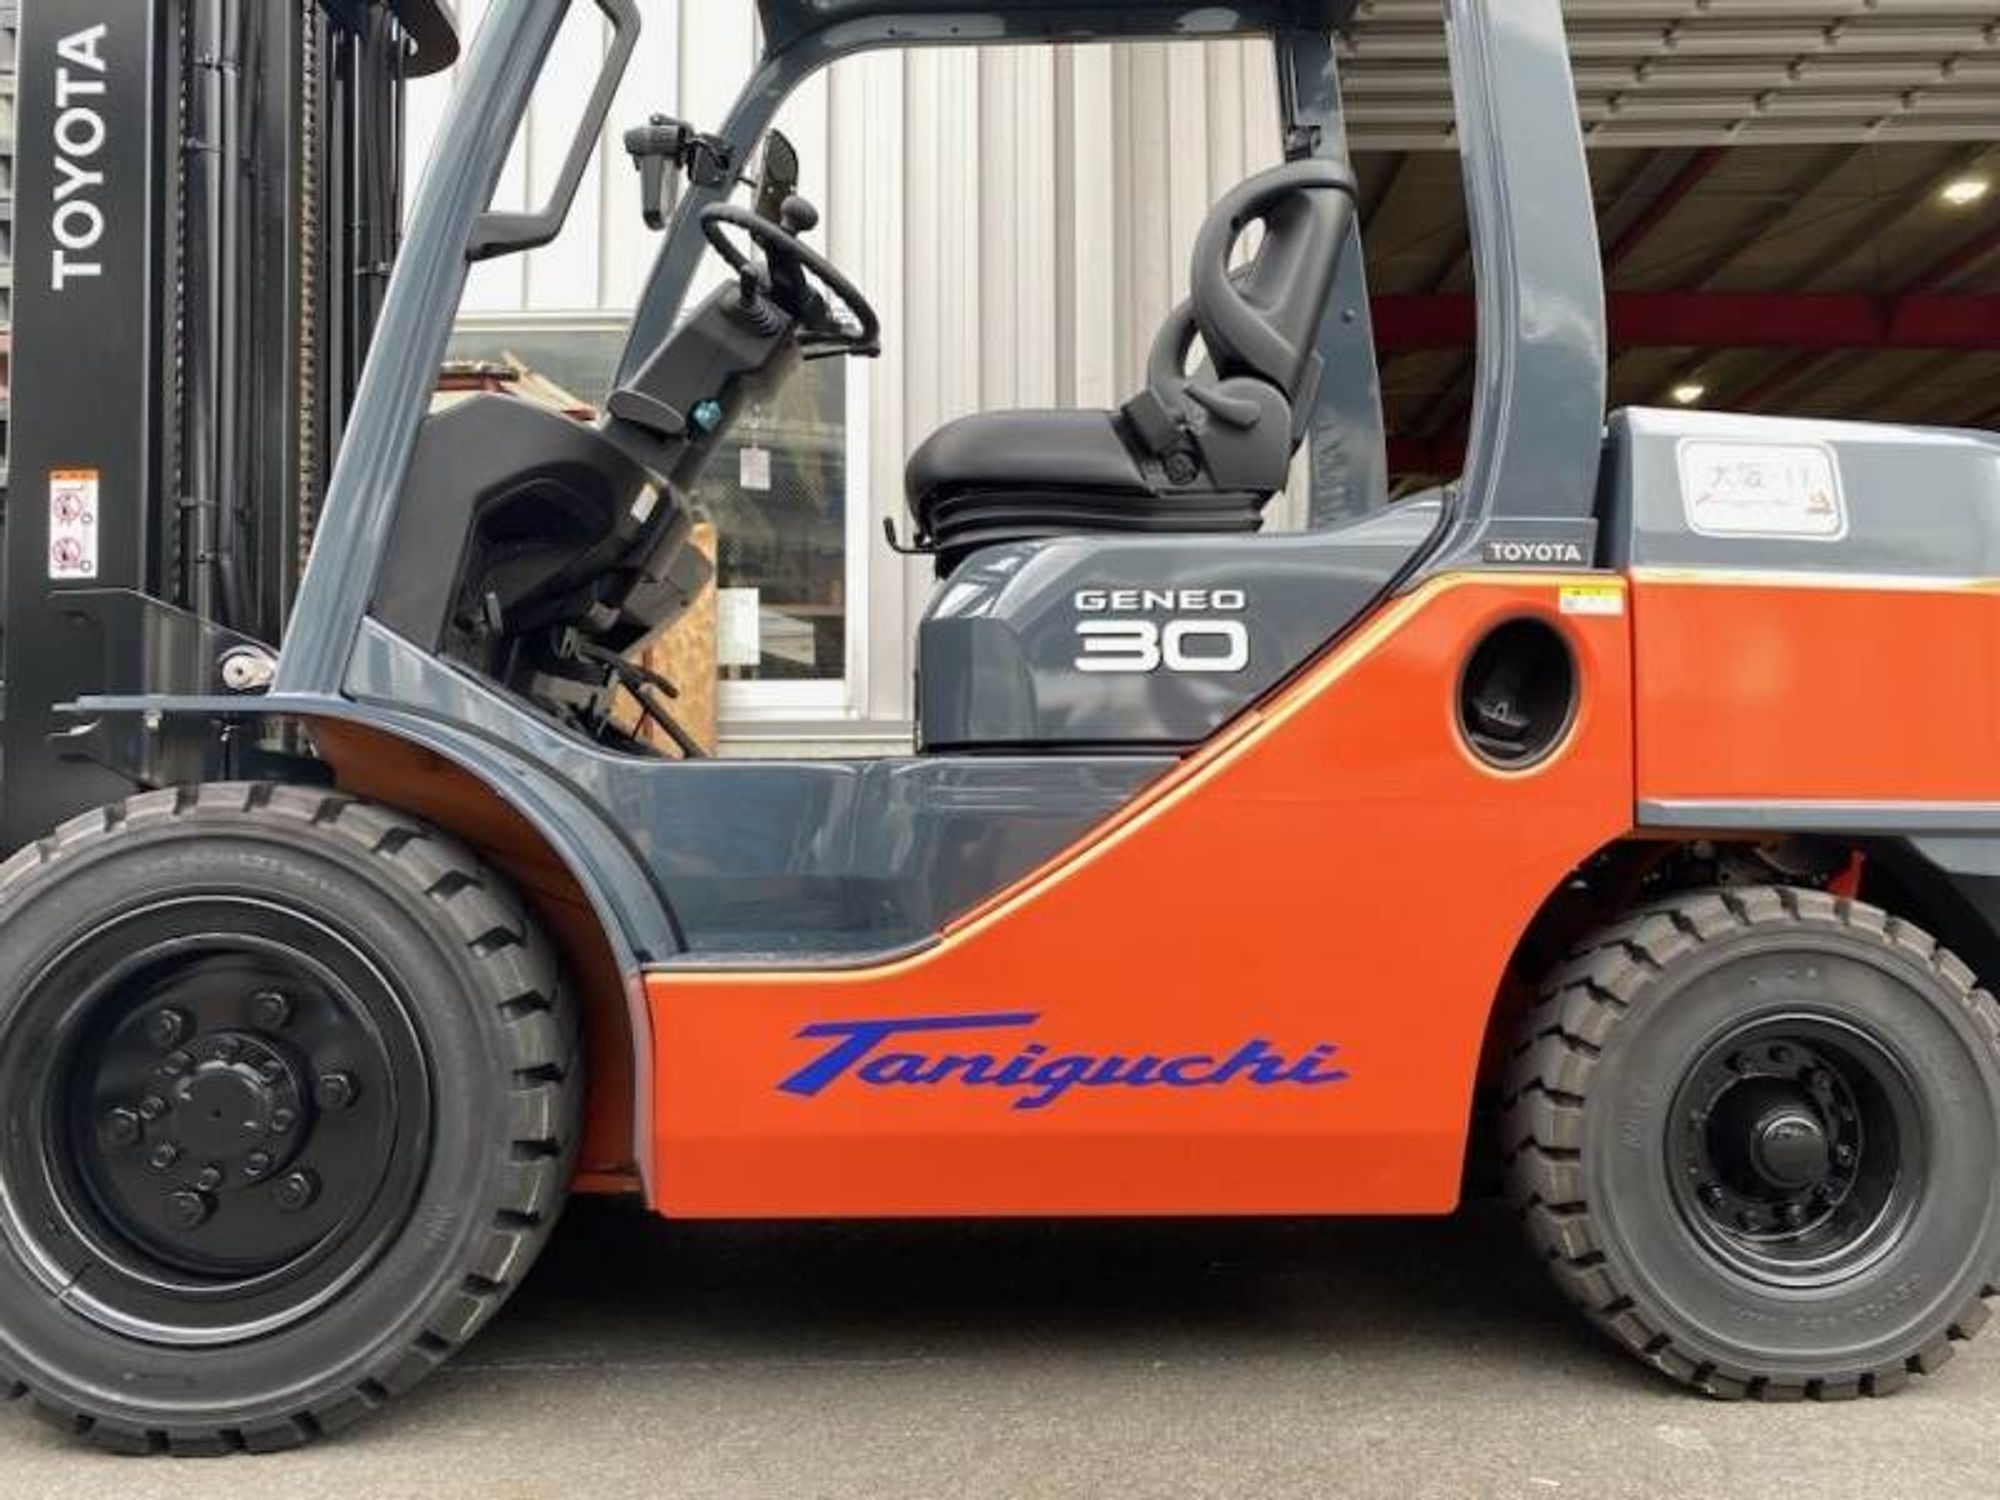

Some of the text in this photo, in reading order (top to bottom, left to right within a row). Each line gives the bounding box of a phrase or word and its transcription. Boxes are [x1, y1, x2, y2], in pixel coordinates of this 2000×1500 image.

[52, 23, 107, 291] TOYOTA
[1491, 542, 1581, 561] TOYOTA
[1074, 589, 1245, 611] GENEO
[1074, 619, 1249, 671] 30
[776, 1012, 1349, 1110] Taniguchi
